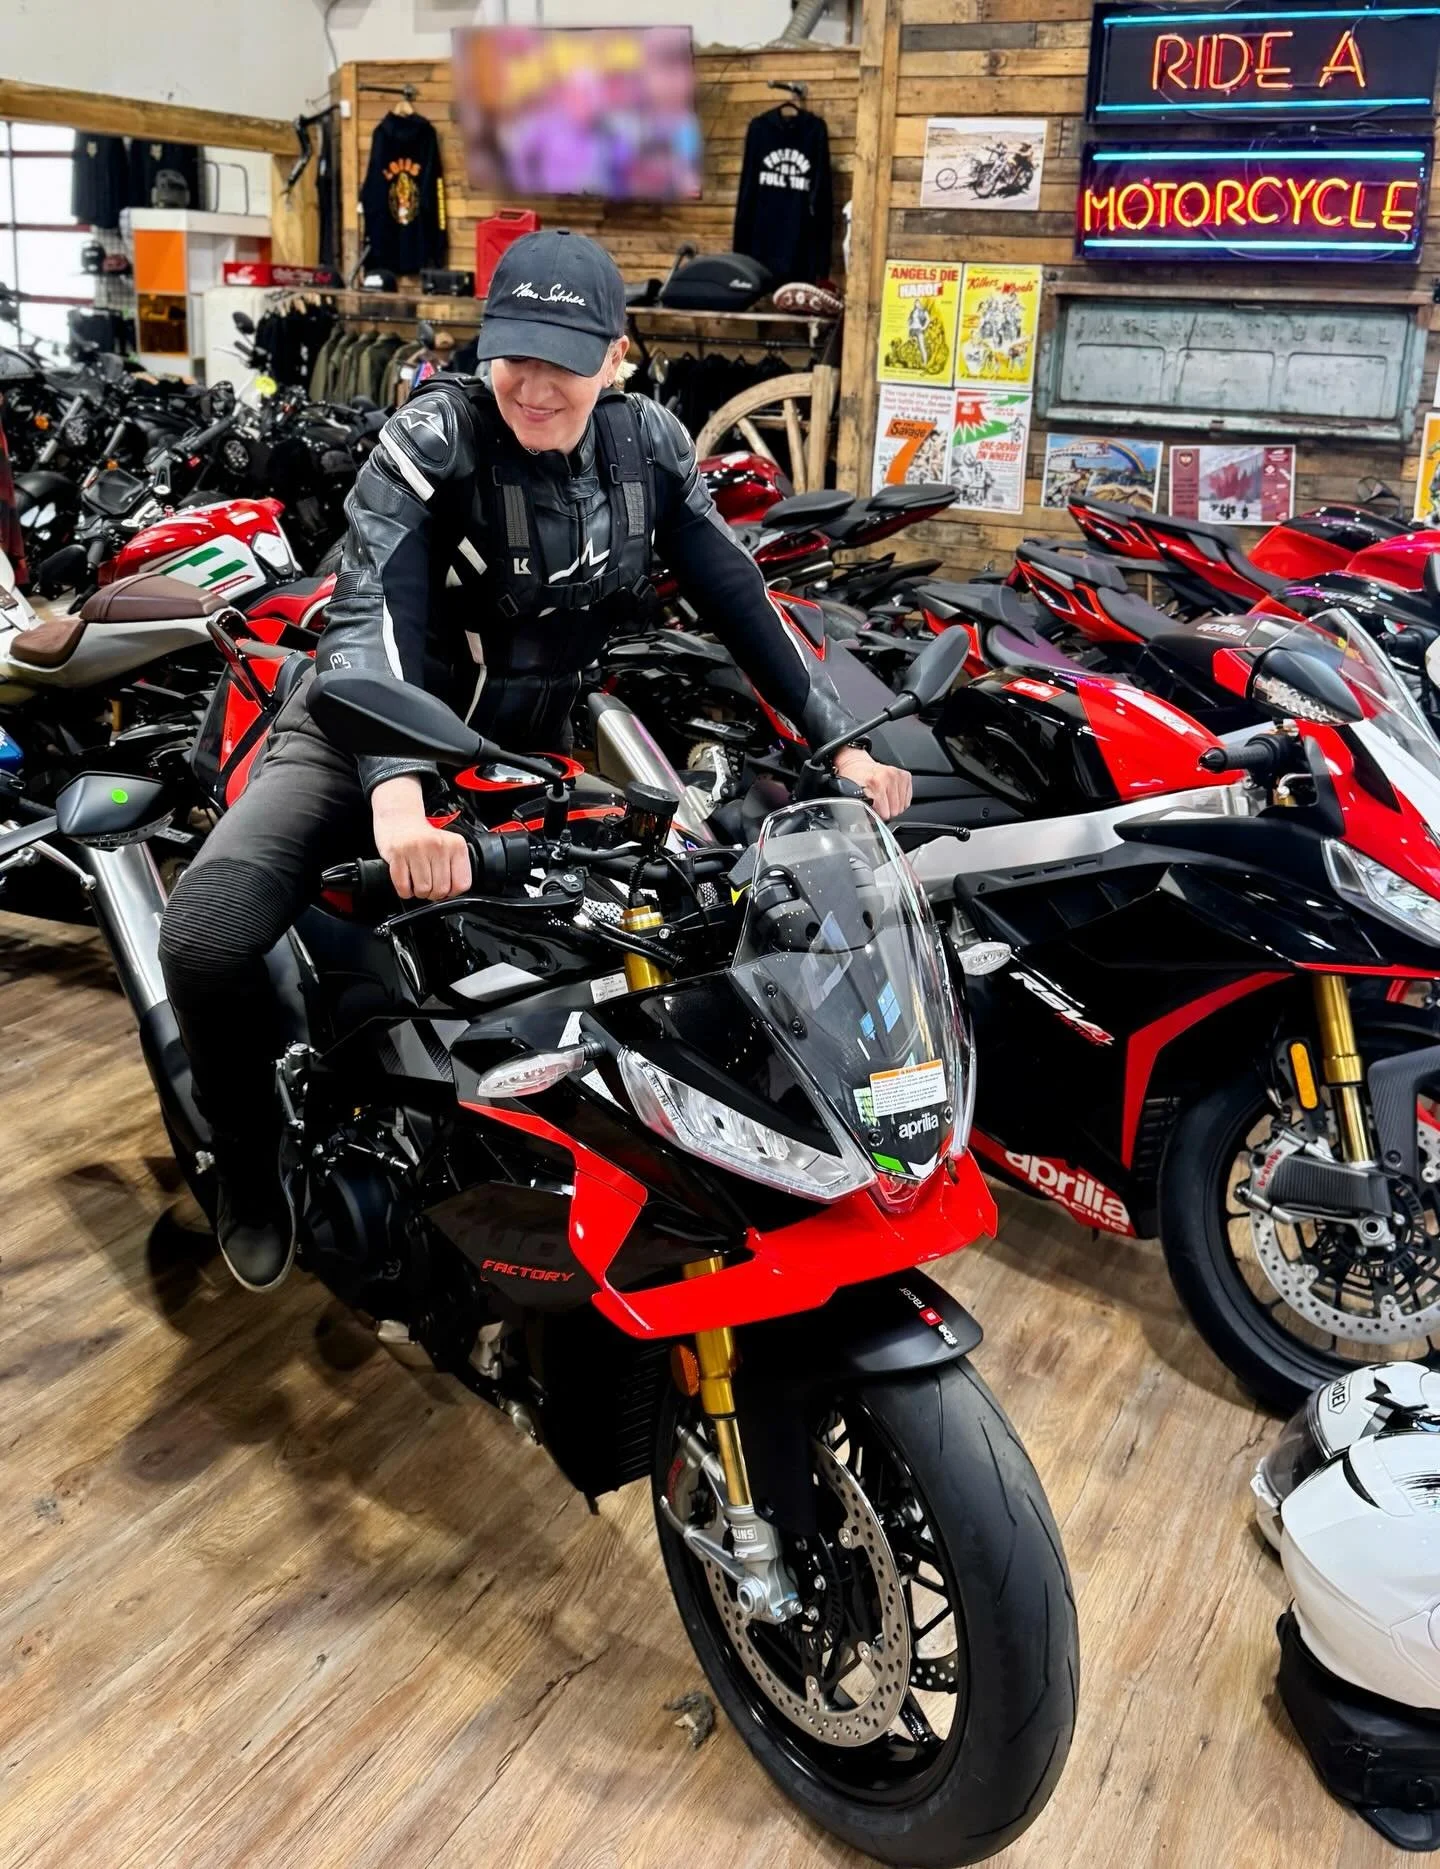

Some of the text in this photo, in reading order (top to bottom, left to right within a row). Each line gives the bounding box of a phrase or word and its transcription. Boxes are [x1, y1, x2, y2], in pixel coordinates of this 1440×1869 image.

[1152, 30, 1365, 90] RIDE A
[763, 147, 811, 175] FREEDOM
[759, 171, 787, 188] FULL
[1084, 177, 1418, 231] MOTORCYCLE
[939, 269, 959, 282] DIE
[890, 421, 926, 439] Savage
[1197, 622, 1248, 637] aprilia
[898, 1112, 940, 1140] aprilia
[1005, 1150, 1130, 1226] aprilia
[1039, 1184, 1128, 1233] RACING
[482, 1259, 575, 1282] FACTORY
[899, 1287, 926, 1310] racer
